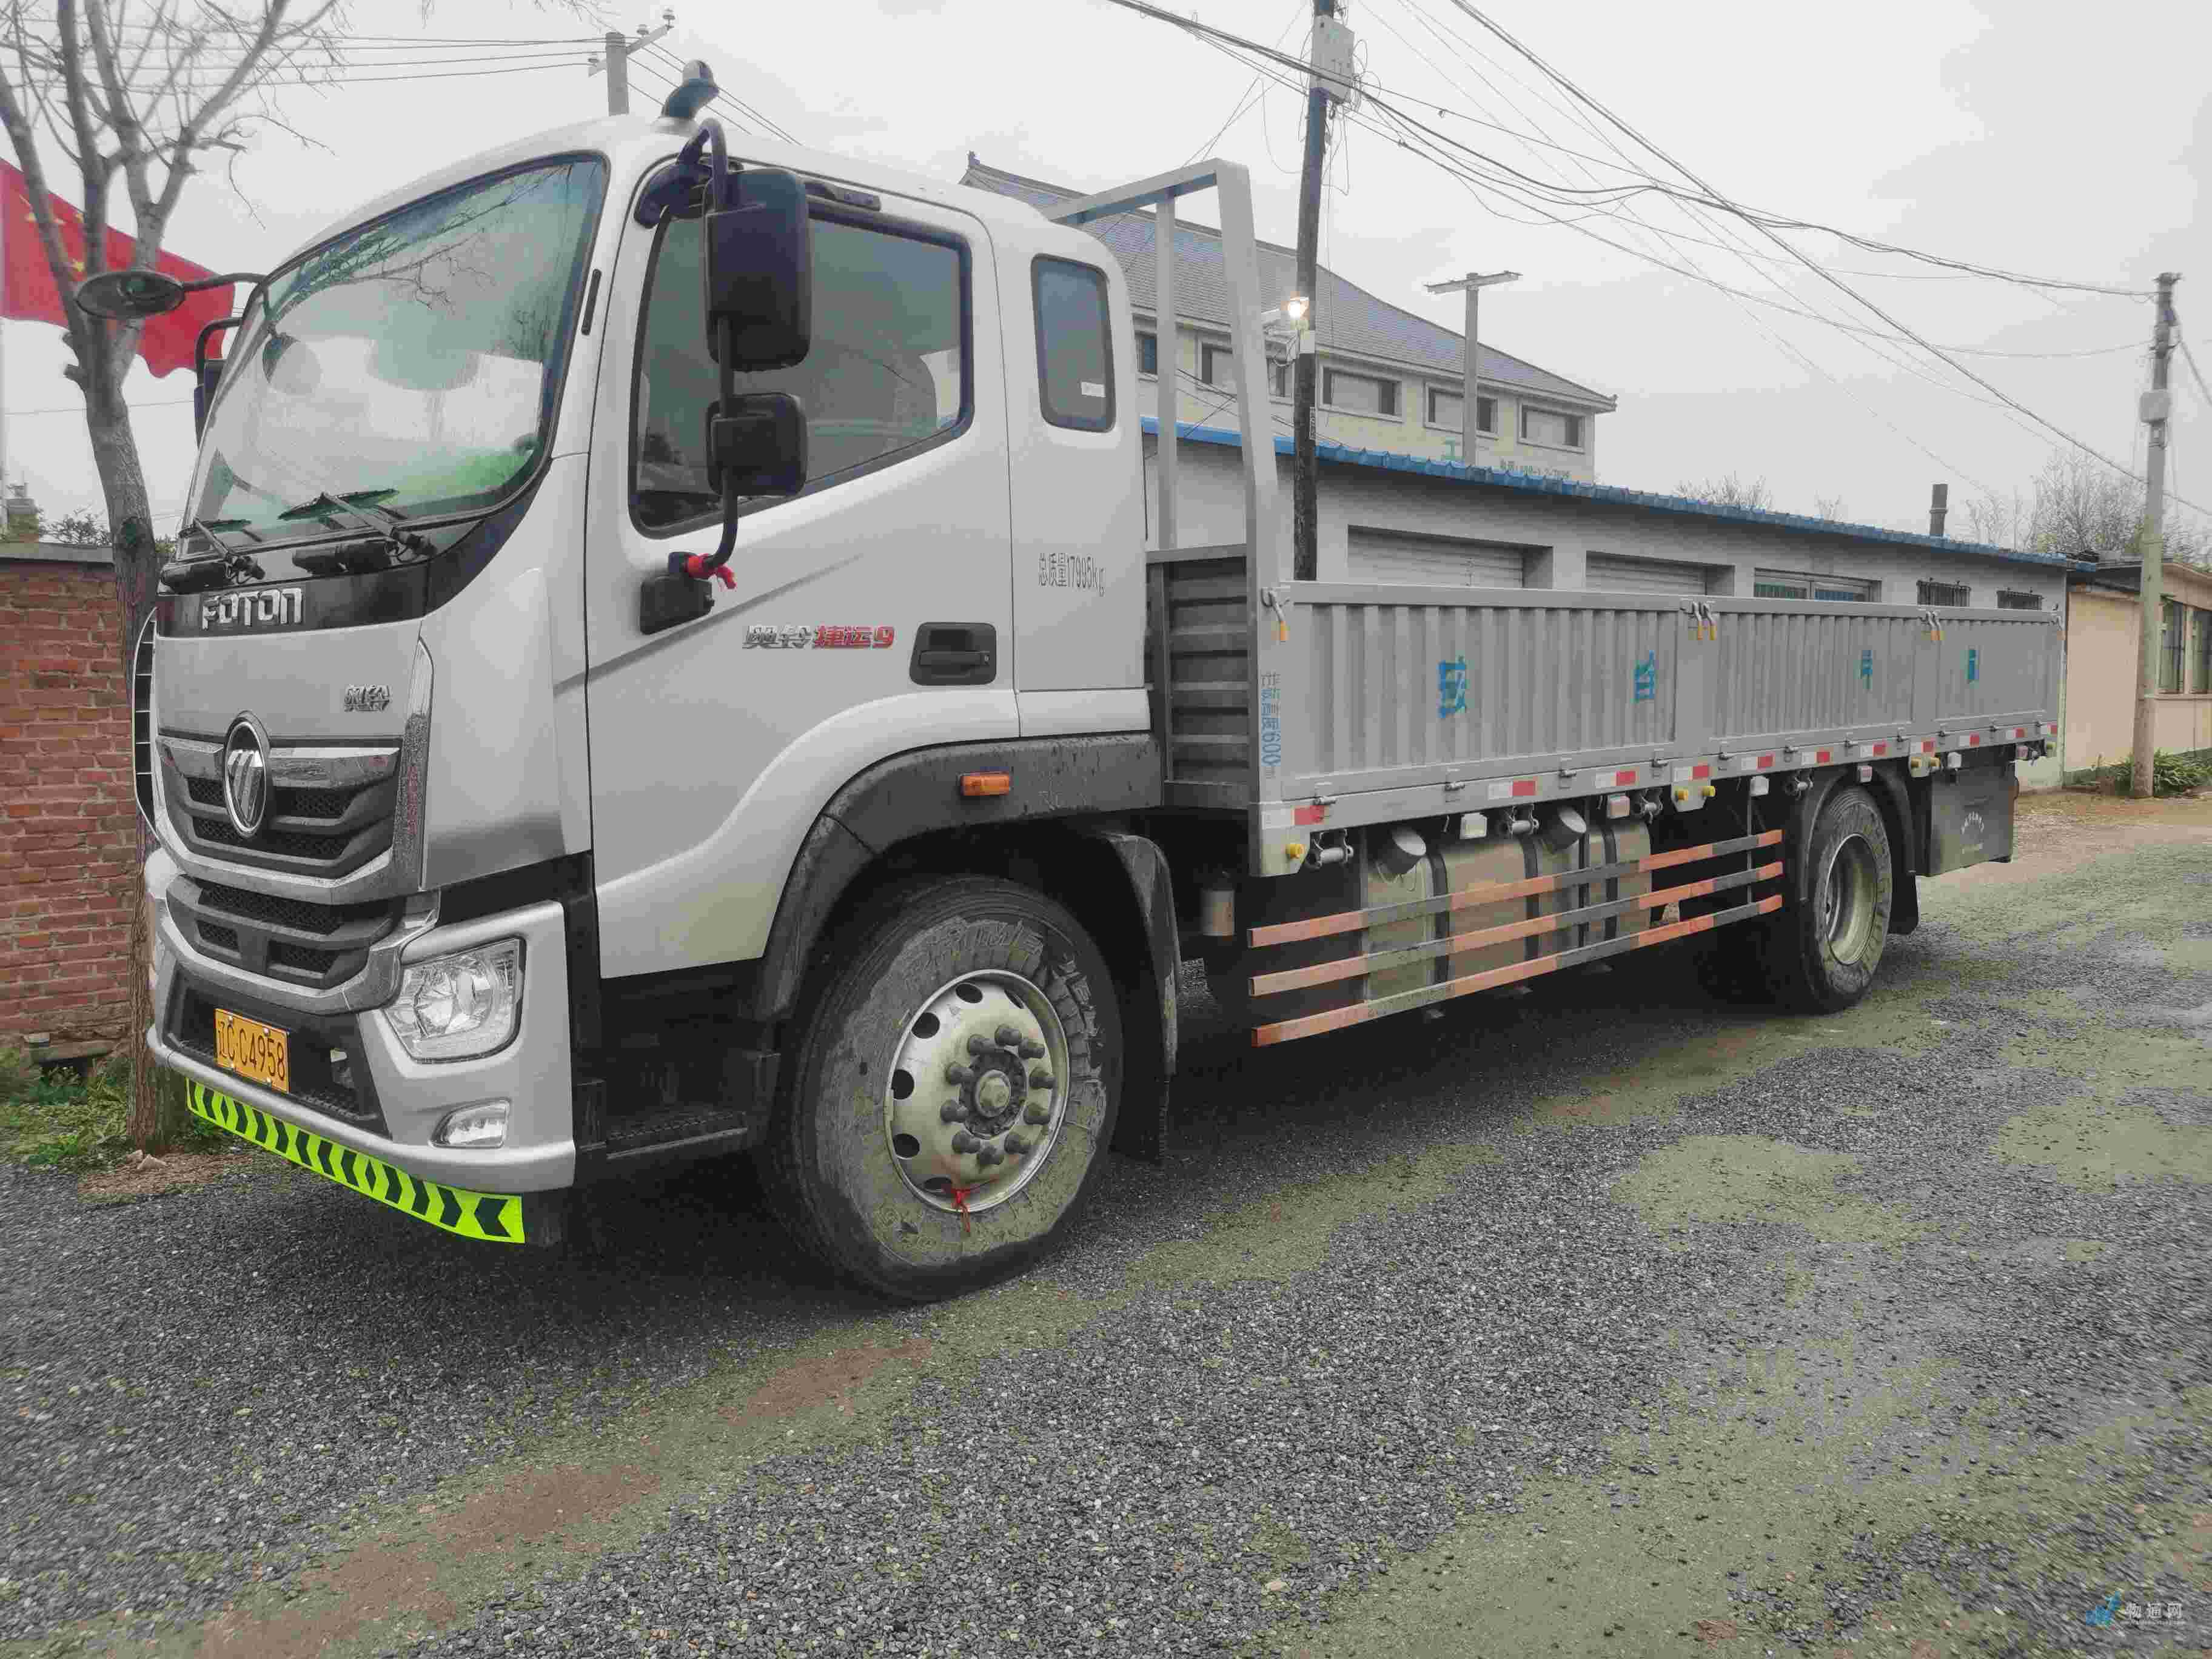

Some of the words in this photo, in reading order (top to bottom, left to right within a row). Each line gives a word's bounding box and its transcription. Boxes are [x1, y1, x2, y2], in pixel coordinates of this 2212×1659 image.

[1037, 552, 1105, 597] 总质量17995kg
[202, 588, 302, 631] FOTON
